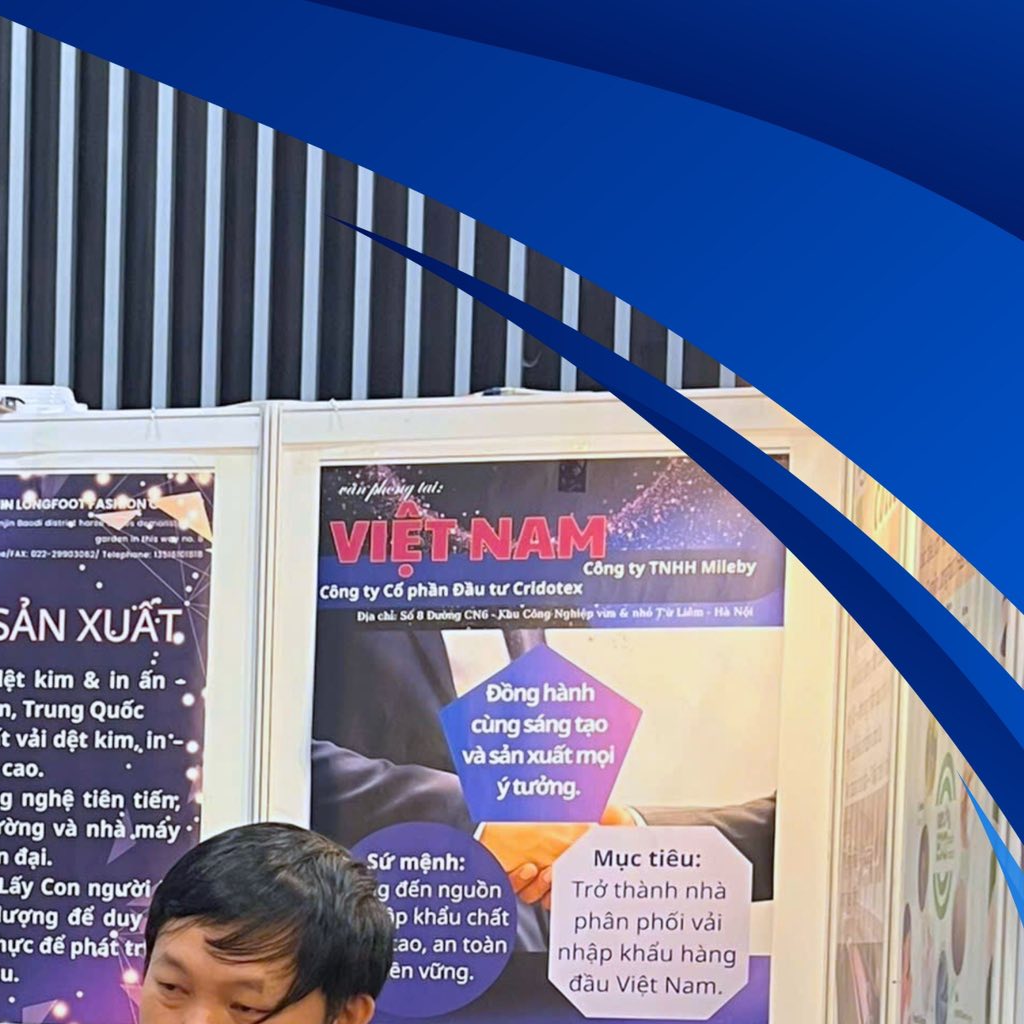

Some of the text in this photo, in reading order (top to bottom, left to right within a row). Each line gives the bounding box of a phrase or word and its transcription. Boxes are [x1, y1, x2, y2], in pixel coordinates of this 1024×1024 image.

[330, 500, 607, 577] VIỆT NAM
[583, 560, 756, 578] Công ty TNHH Mileby
[320, 581, 583, 600] Công ty phần Đầu tư Cridotex
[76, 599, 183, 643] XUẤT
[34, 669, 74, 689] kim
[83, 670, 100, 689] &
[109, 670, 130, 690] in
[138, 669, 166, 690] ấn
[485, 681, 596, 708] Đồng hành
[22, 700, 84, 724] Trung
[89, 699, 145, 723] Quốc
[471, 713, 609, 739] cùng sáng tạo
[15, 727, 47, 748] vải
[53, 729, 89, 753] dệt
[94, 730, 144, 754] kim,
[146, 730, 166, 750] in
[461, 743, 615, 769] và sản xuất mọi
[2, 762, 44, 778] cao.
[22, 788, 75, 813] nghệ
[82, 789, 125, 809] tiên
[496, 775, 581, 801] ý tưởng.
[52, 818, 78, 837] và
[86, 819, 126, 839] nhà
[132, 816, 181, 844] máy
[14, 846, 53, 870] đại.
[367, 852, 465, 875] Sứ mệnh:
[594, 849, 701, 872] Mục tiêu:
[40, 877, 80, 897] Con
[88, 879, 154, 905] người
[395, 879, 432, 898] đến
[438, 879, 502, 903] nguồn
[572, 878, 726, 900] Trở thành nhà
[67, 905, 95, 926] để
[103, 908, 145, 934] duy
[413, 905, 461, 926] khẩu
[466, 906, 510, 927] chất
[574, 911, 722, 936] phân phối vải
[39, 934, 67, 955] để
[70, 935, 120, 960] phát
[432, 939, 457, 953] an
[462, 935, 507, 954] toàn
[558, 941, 736, 969] nhập khẩu hàng
[418, 962, 474, 985] vững.
[569, 973, 723, 995] đầu Việt Nam.
